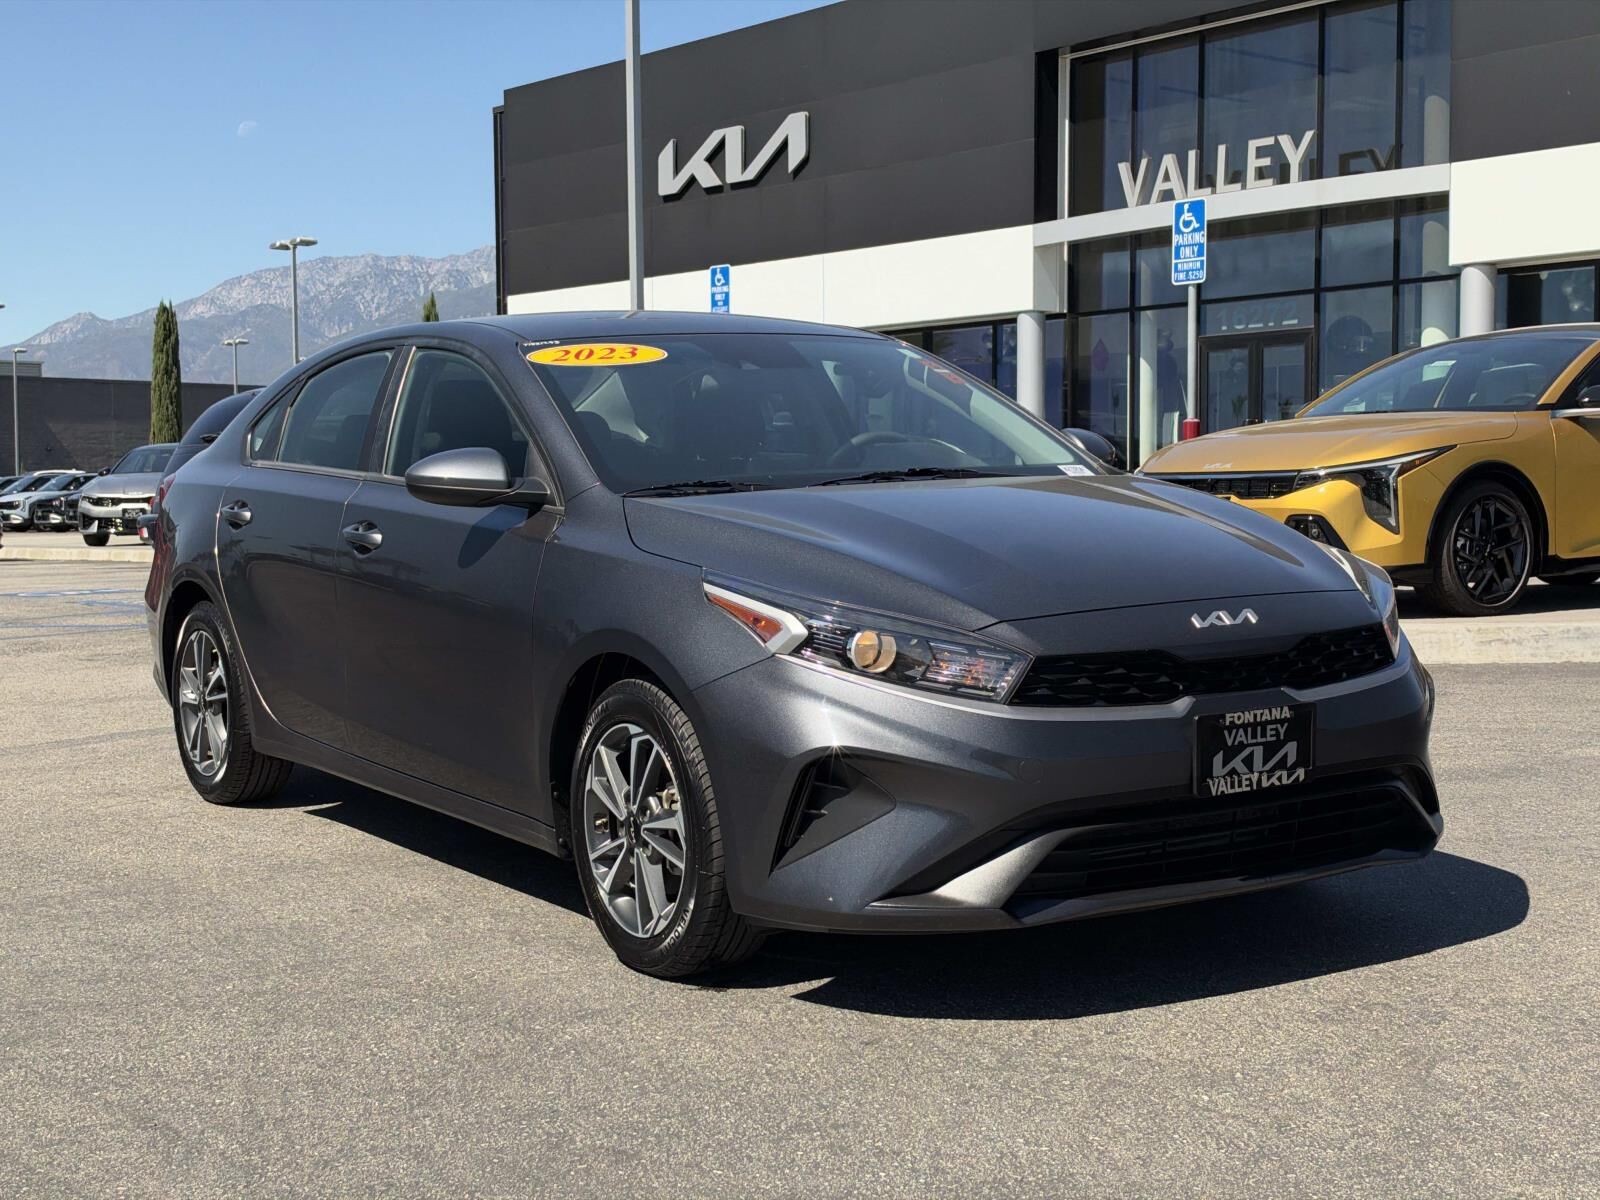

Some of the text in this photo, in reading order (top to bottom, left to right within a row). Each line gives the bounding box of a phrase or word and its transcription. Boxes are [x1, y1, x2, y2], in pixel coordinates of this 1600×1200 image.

[658, 111, 809, 196] KIA
[1118, 130, 1315, 208] VALLEY
[1174, 231, 1204, 247] PARKING
[1180, 245, 1199, 259] ONLY
[1174, 272, 1186, 281] FINE
[1177, 261, 1201, 271] MINIMUM
[551, 347, 639, 362] 2023
[1191, 608, 1259, 629] KIA
[1225, 705, 1291, 726] FONTANA
[1223, 722, 1289, 747] VALLEY
[1212, 741, 1298, 778] KIA
[1207, 768, 1305, 797] VALLEY KIA
